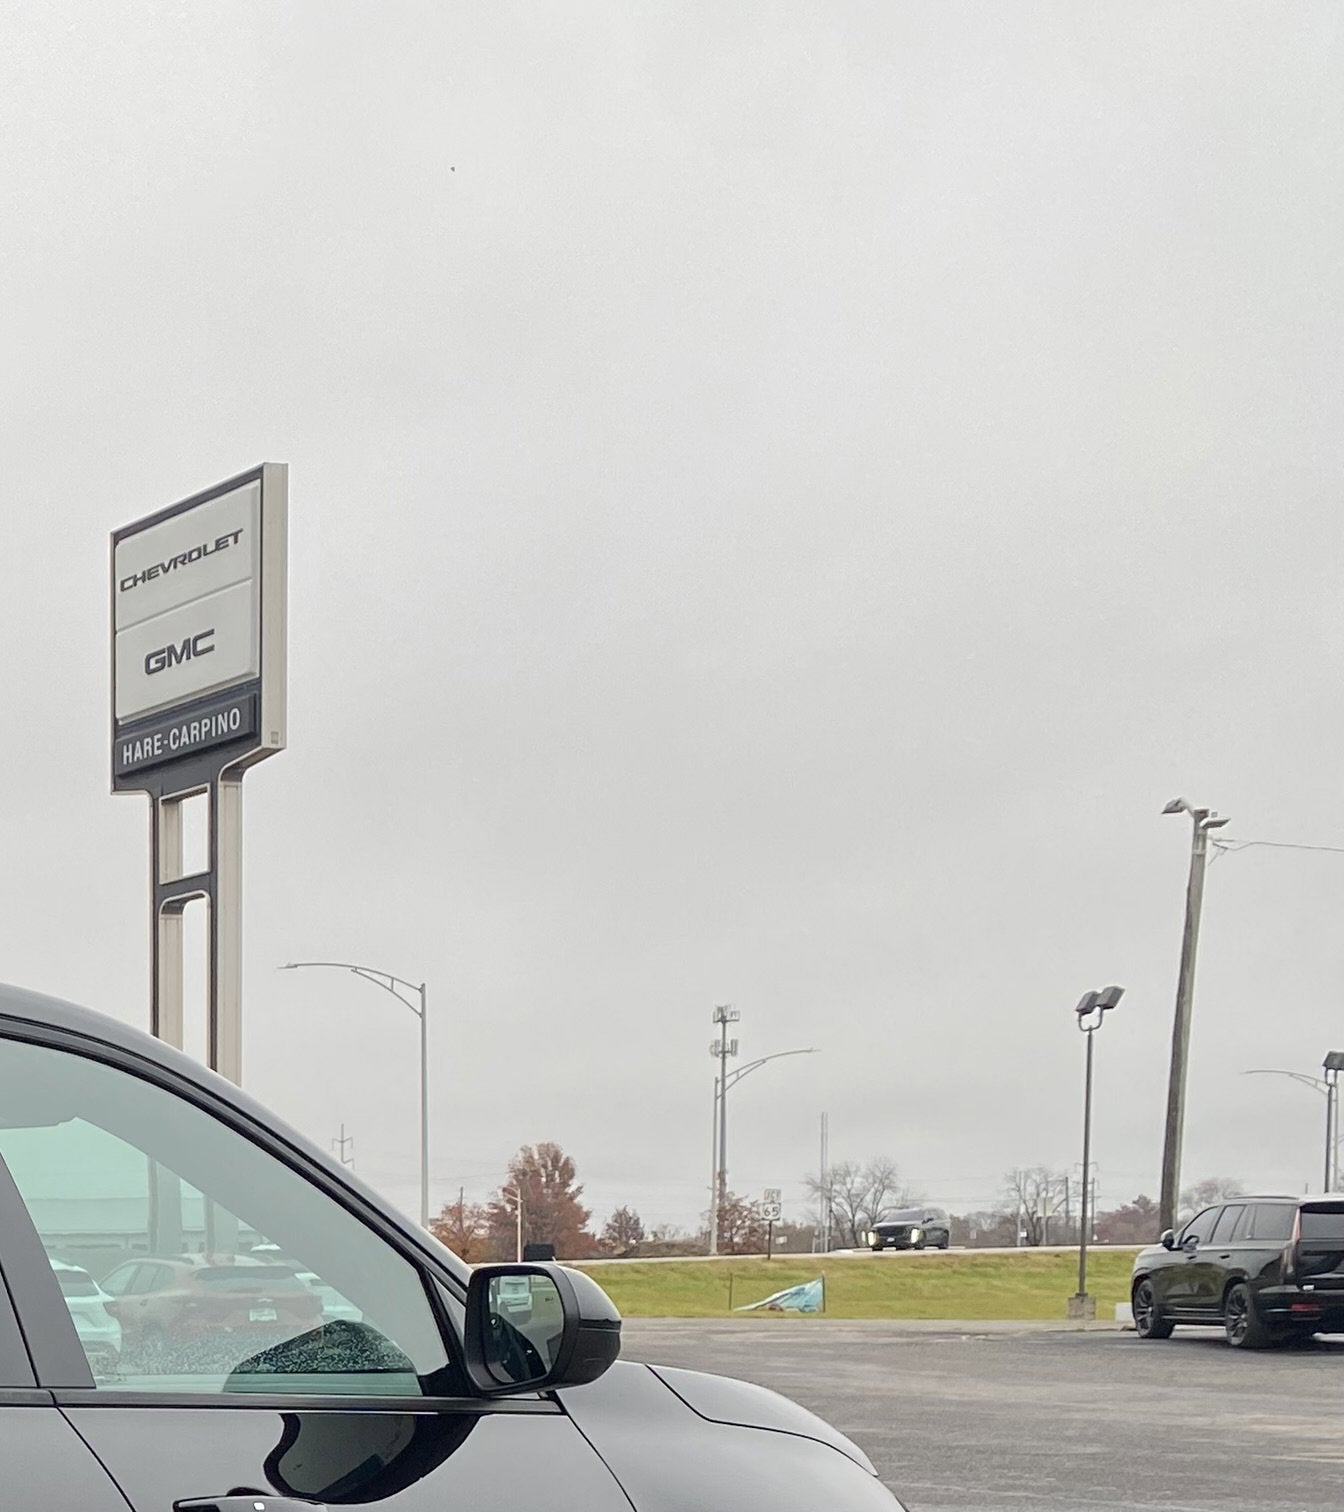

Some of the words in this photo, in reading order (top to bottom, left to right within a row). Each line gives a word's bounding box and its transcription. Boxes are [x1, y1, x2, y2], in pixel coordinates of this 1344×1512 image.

[120, 528, 243, 592] CHEVROLET
[145, 629, 215, 675] GMC
[123, 707, 240, 765] HARE-CARPINO
[764, 1206, 779, 1217] 65
